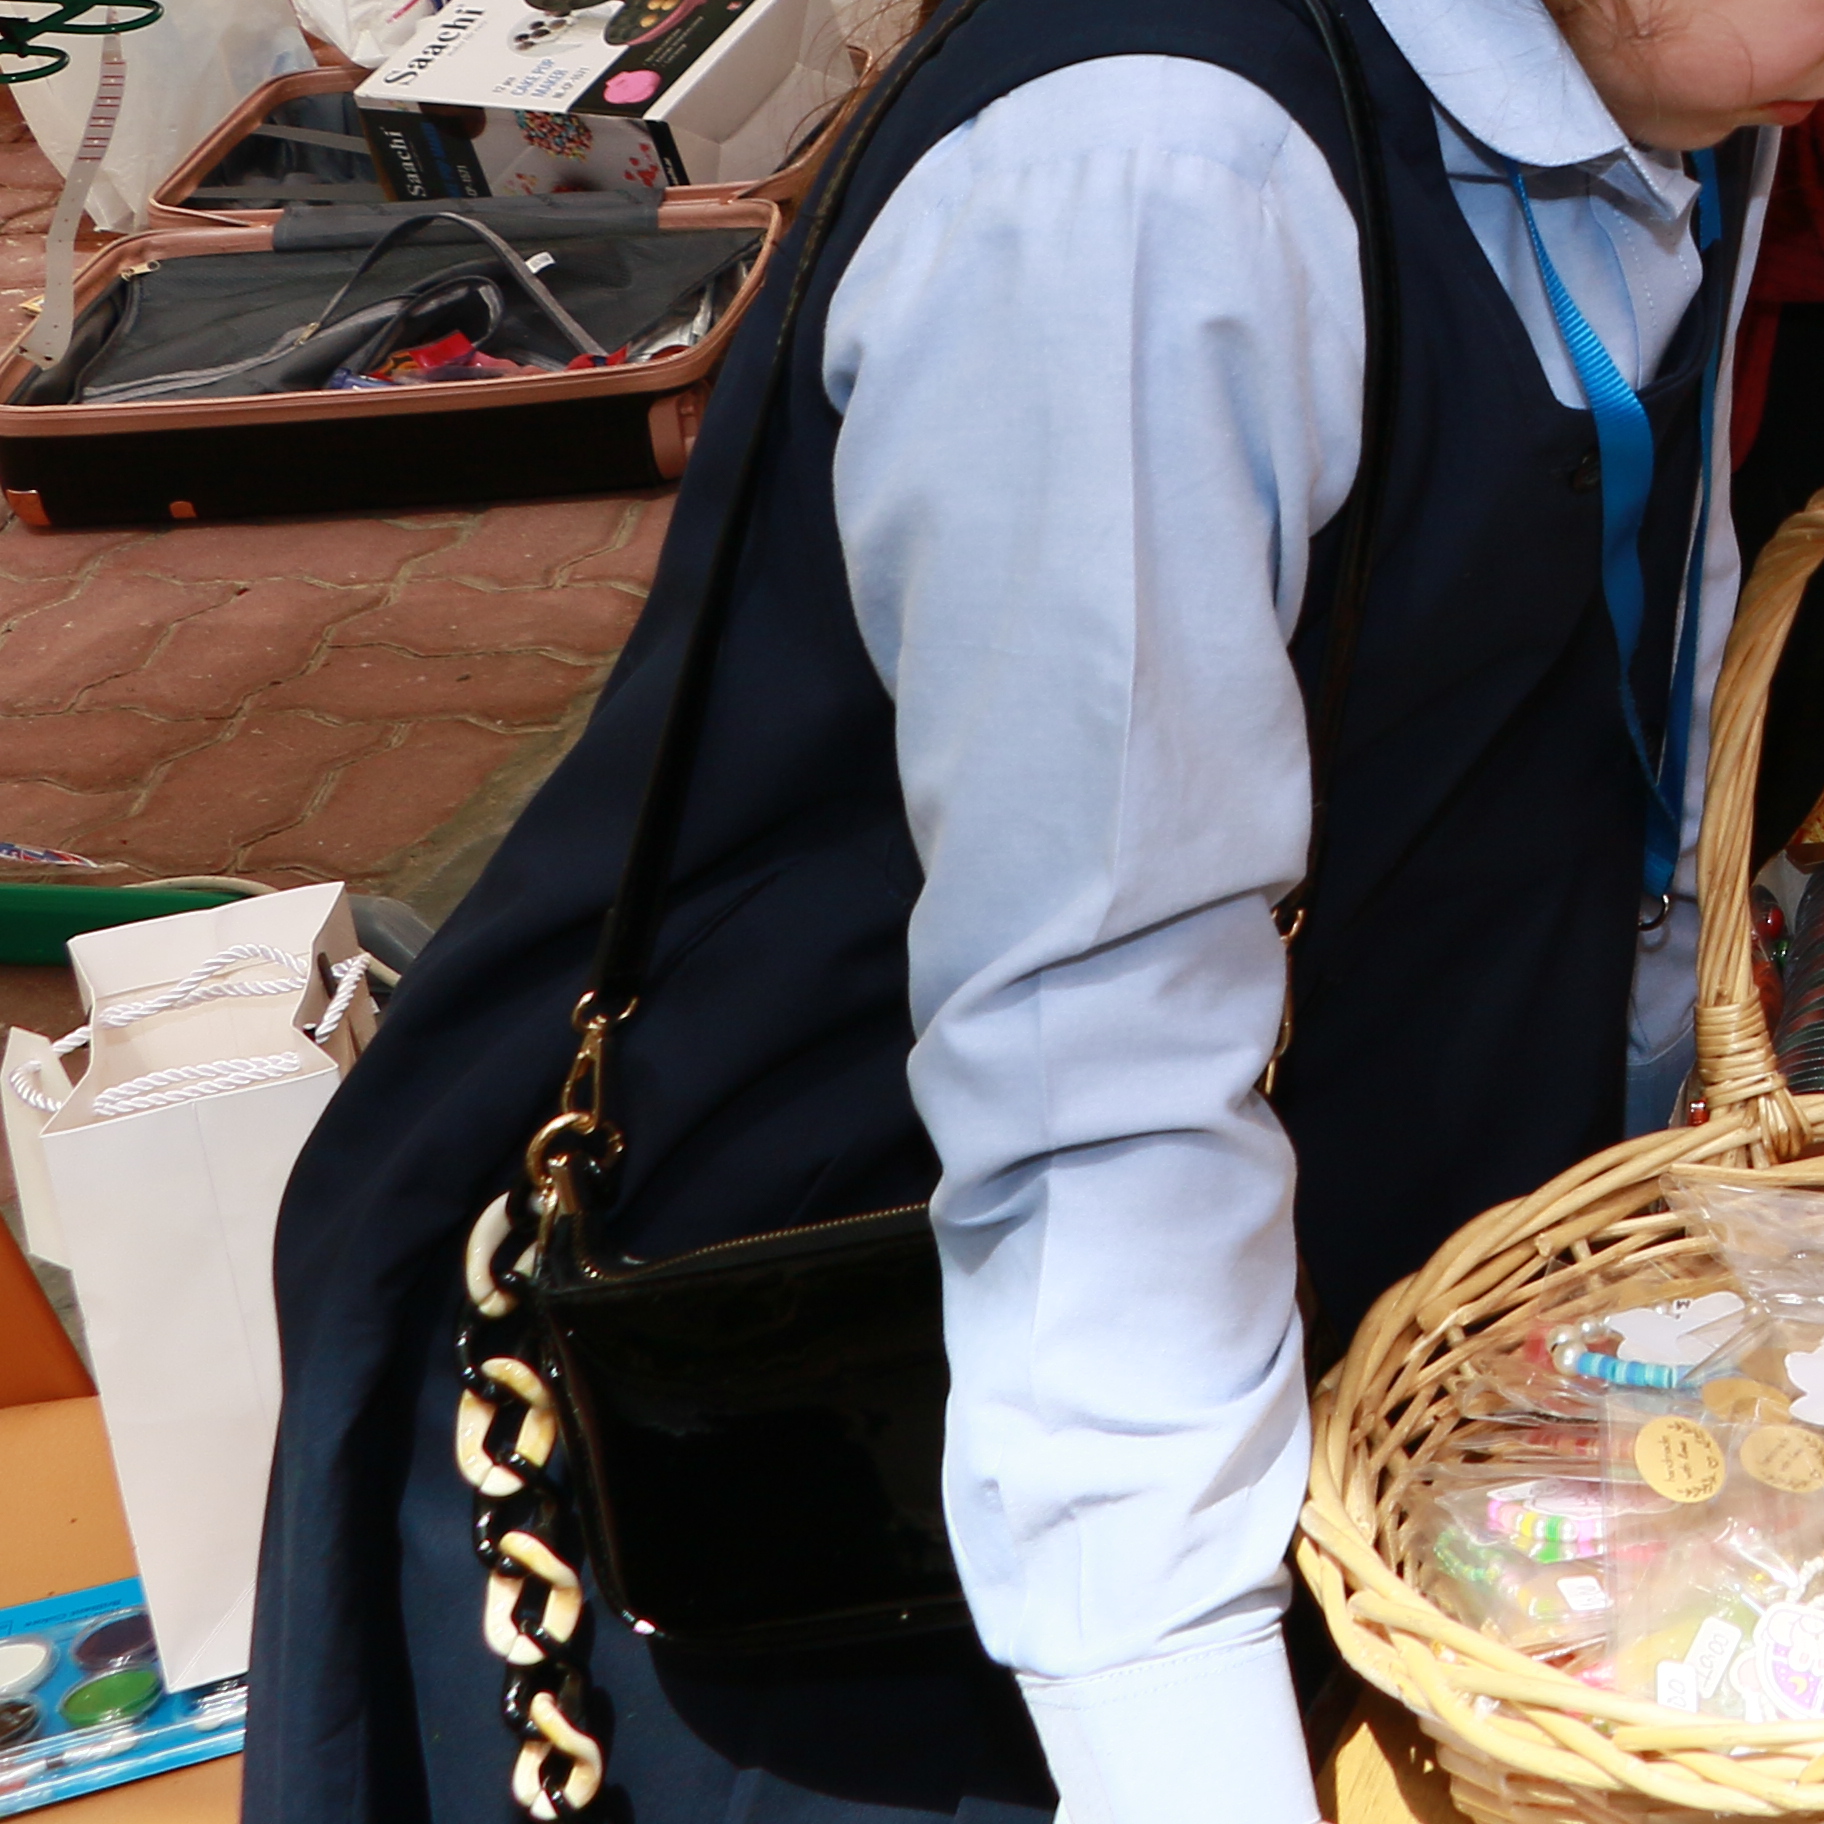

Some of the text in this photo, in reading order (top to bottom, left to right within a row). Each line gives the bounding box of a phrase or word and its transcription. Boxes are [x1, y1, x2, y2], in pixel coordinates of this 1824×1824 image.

[384, 4, 486, 87] Saachi
[511, 71, 537, 98] CAKE
[531, 68, 568, 100] MAKER
[386, 127, 427, 199] Saachi
